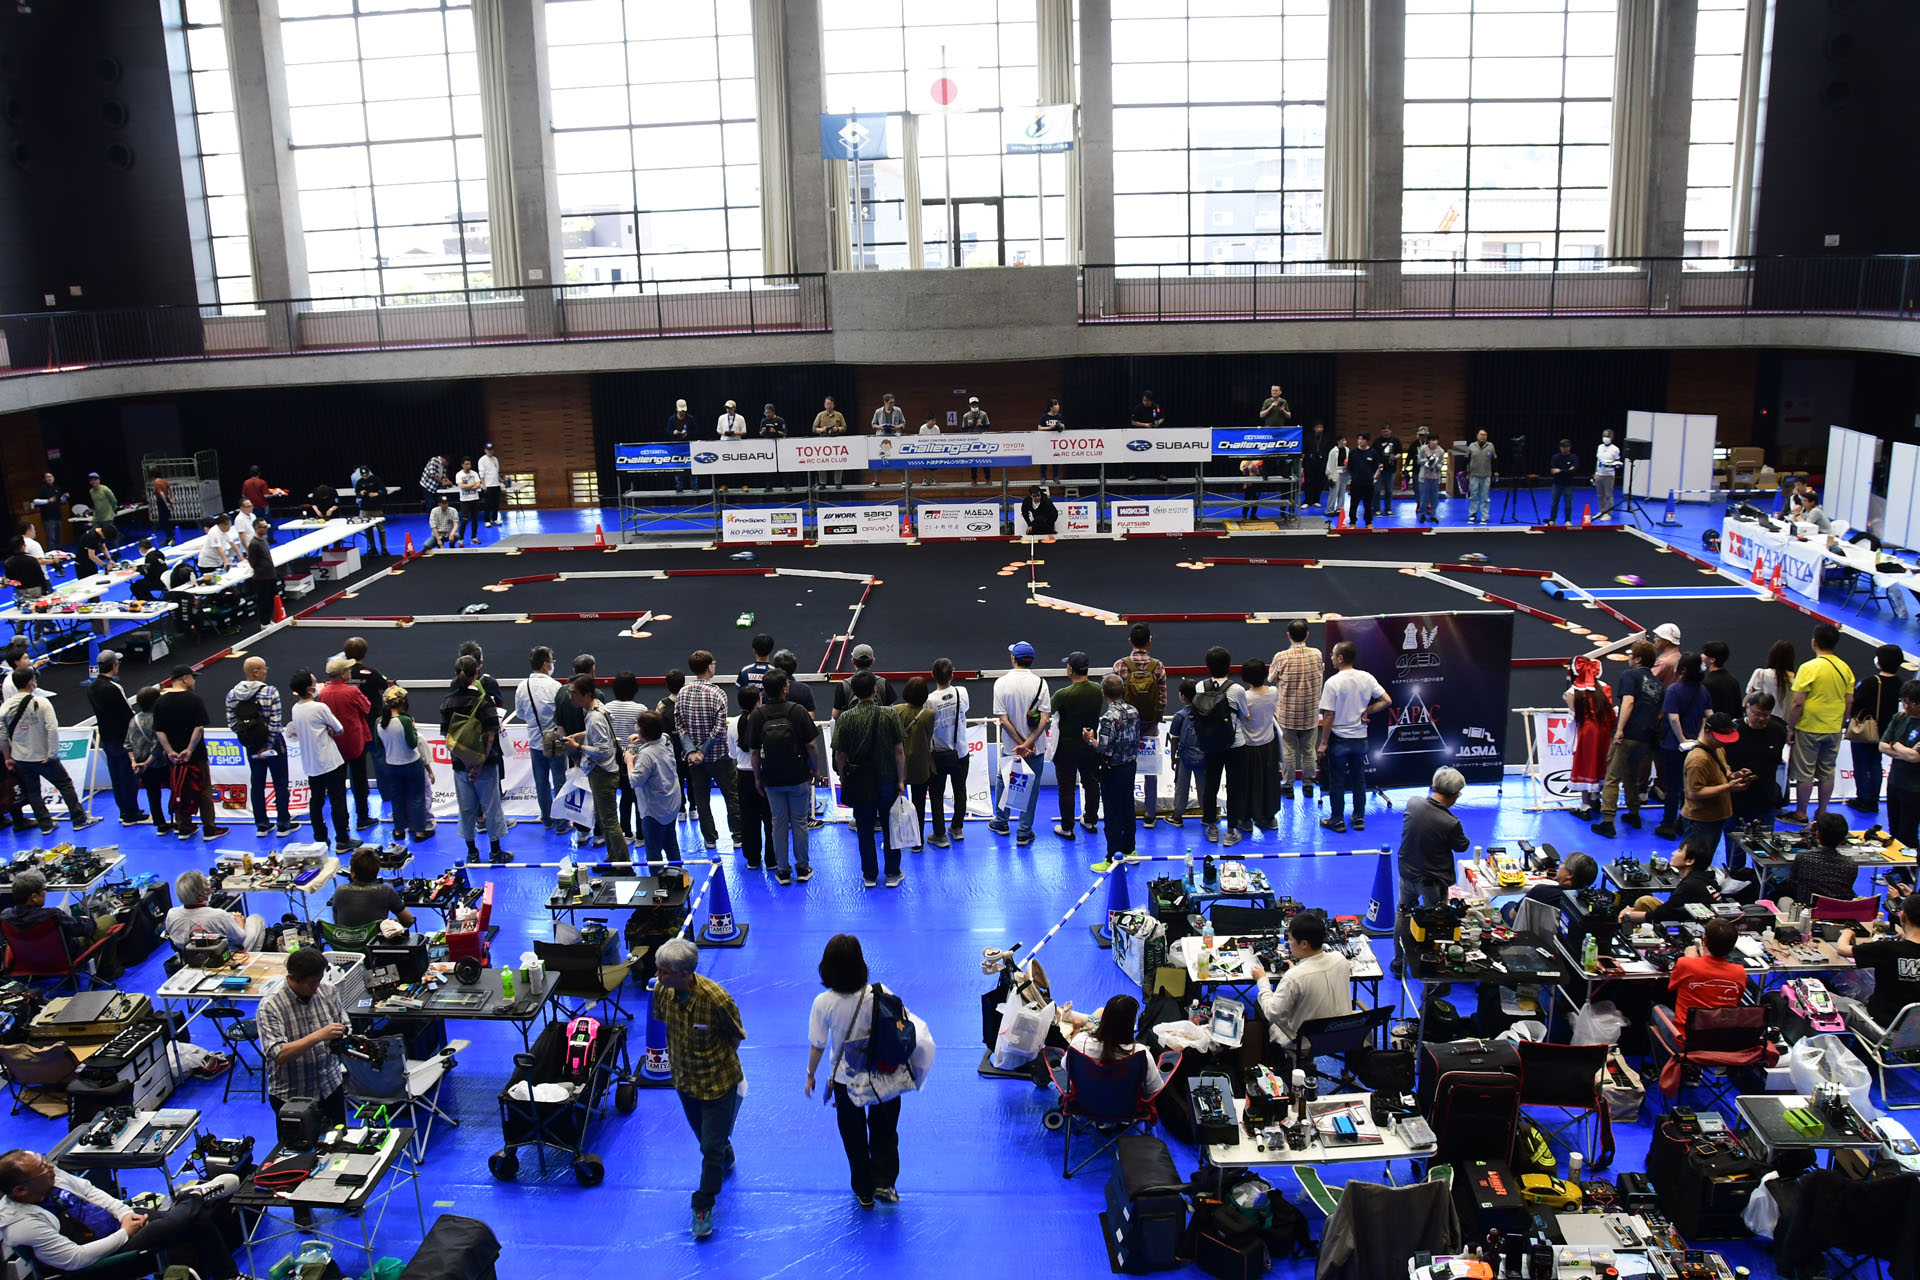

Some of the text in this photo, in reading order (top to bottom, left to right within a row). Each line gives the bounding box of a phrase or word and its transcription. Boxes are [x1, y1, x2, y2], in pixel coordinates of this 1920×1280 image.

[899, 442, 999, 455] Challenge Cup
[1050, 439, 1104, 449] TOYOTA
[1156, 441, 1209, 449] SUBARU
[1218, 440, 1299, 450] Challenge Cup
[796, 445, 849, 457] TOYOTA
[722, 452, 774, 461] SUBARU
[904, 525, 910, 533] 5
[1754, 543, 1814, 583] TAMIYA
[318, 568, 330, 580] 2
[1388, 705, 1440, 725] NAPAC
[1456, 746, 1497, 756] JASMA
[710, 925, 733, 933] TAMIYA
